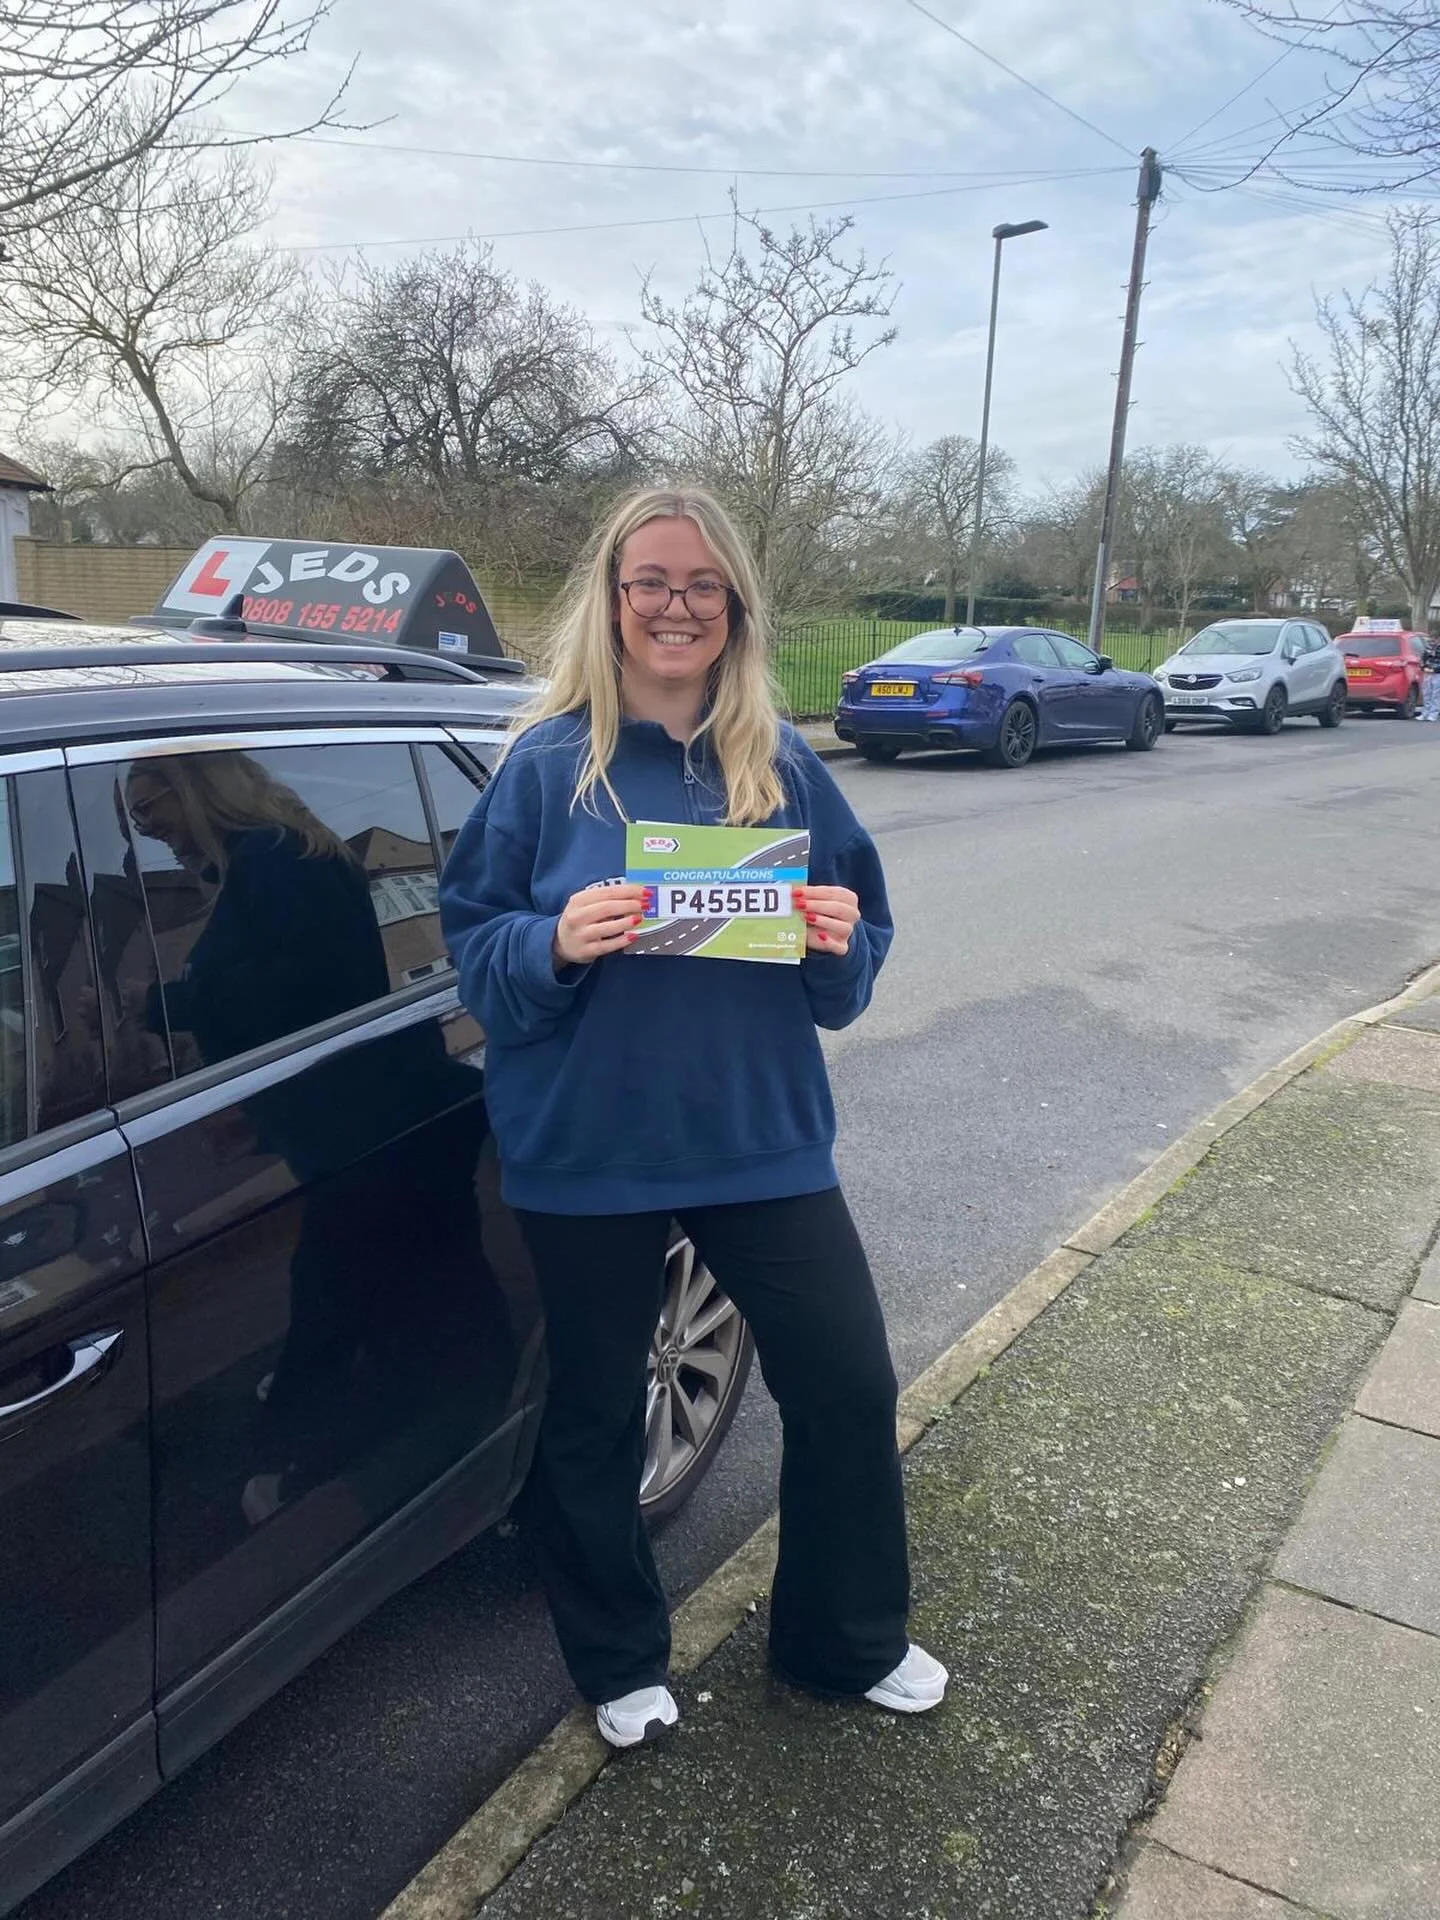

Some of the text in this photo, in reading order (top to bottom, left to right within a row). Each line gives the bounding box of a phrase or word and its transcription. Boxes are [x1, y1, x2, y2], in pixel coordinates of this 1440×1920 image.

[189, 550, 232, 597] L
[251, 550, 410, 604] JEDS
[242, 597, 403, 633] 0808 155 5214
[434, 592, 477, 613] JDS
[663, 870, 774, 882] CONGRATULATIONS
[670, 888, 779, 914] P455ED
